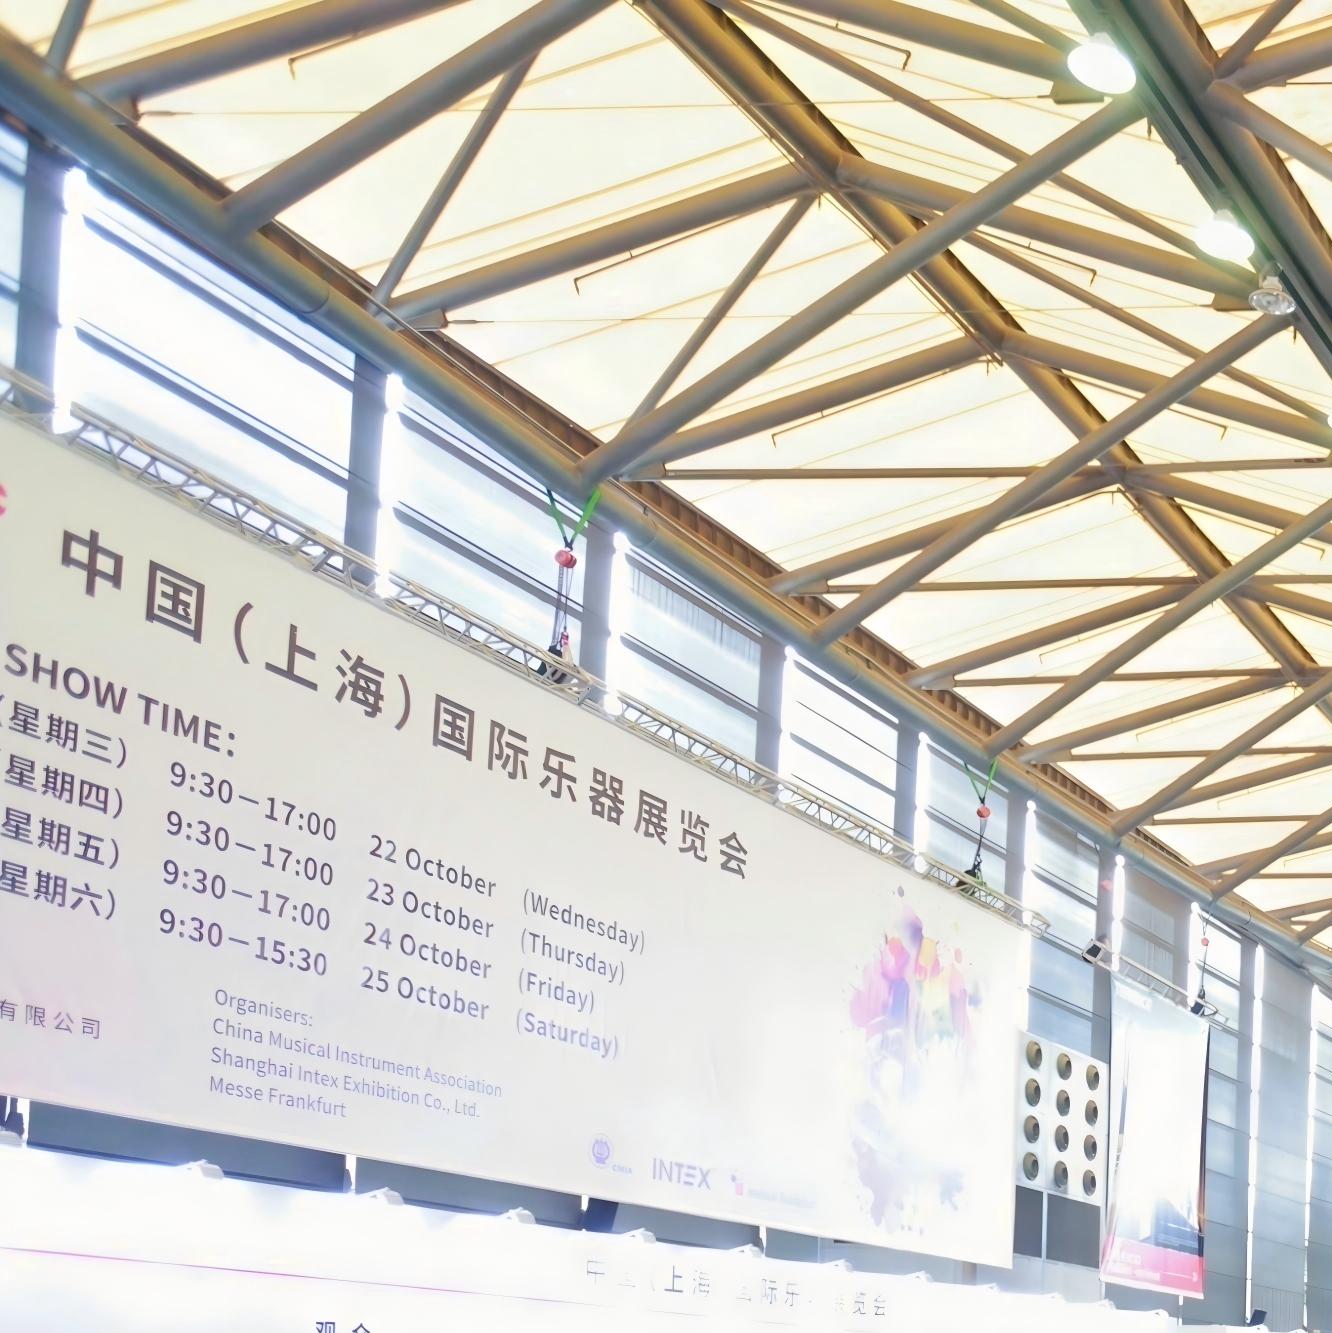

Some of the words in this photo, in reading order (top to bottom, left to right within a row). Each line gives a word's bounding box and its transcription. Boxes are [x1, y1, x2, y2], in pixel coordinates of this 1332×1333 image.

[4, 643, 128, 714] SHOW
[137, 692, 235, 758] TIME:
[366, 878, 394, 906] 23
[402, 891, 494, 938] October
[521, 928, 625, 986] (Thursday)
[369, 834, 397, 863] 22
[405, 848, 496, 897] October
[523, 888, 645, 955] (Wednesday)
[214, 989, 313, 1027] Organisers:
[363, 922, 392, 949] 24
[400, 934, 492, 979] October
[519, 968, 595, 1014] (Friday)
[360, 966, 389, 992] 25
[397, 976, 489, 1020] October
[516, 1008, 618, 1060] (Saturday)
[210, 1075, 263, 1101] Messe
[269, 1088, 346, 1118] Frankfurt
[211, 1047, 293, 1078] Shanghai
[298, 1065, 338, 1089] Intex
[344, 1075, 419, 1106] Exhibition
[424, 1093, 450, 1113] Co.,
[455, 1099, 481, 1118] Ltd.
[213, 1018, 264, 1044] China
[269, 1030, 331, 1060] Musical
[336, 1046, 420, 1080] Instrument
[423, 1067, 502, 1097] Association
[652, 1157, 711, 1190] INTEX
